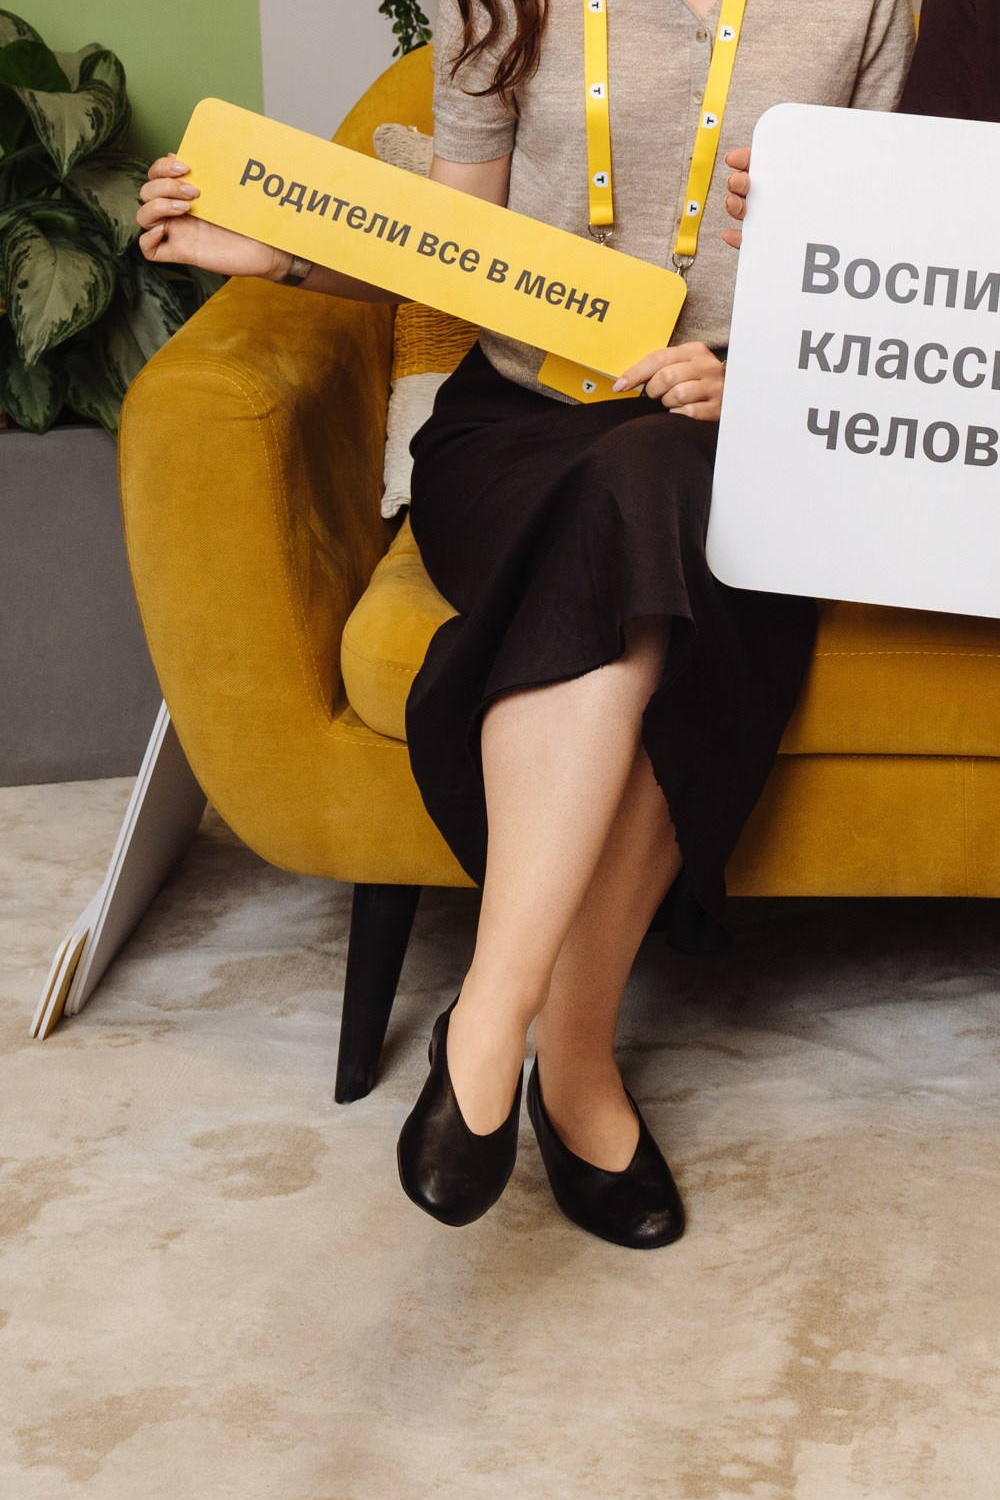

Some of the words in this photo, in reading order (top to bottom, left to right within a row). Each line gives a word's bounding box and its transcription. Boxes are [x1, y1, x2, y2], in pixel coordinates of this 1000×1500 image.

[239, 158, 412, 247] Родители
[416, 231, 481, 273] все
[486, 258, 508, 284] в
[514, 269, 611, 323] меня
